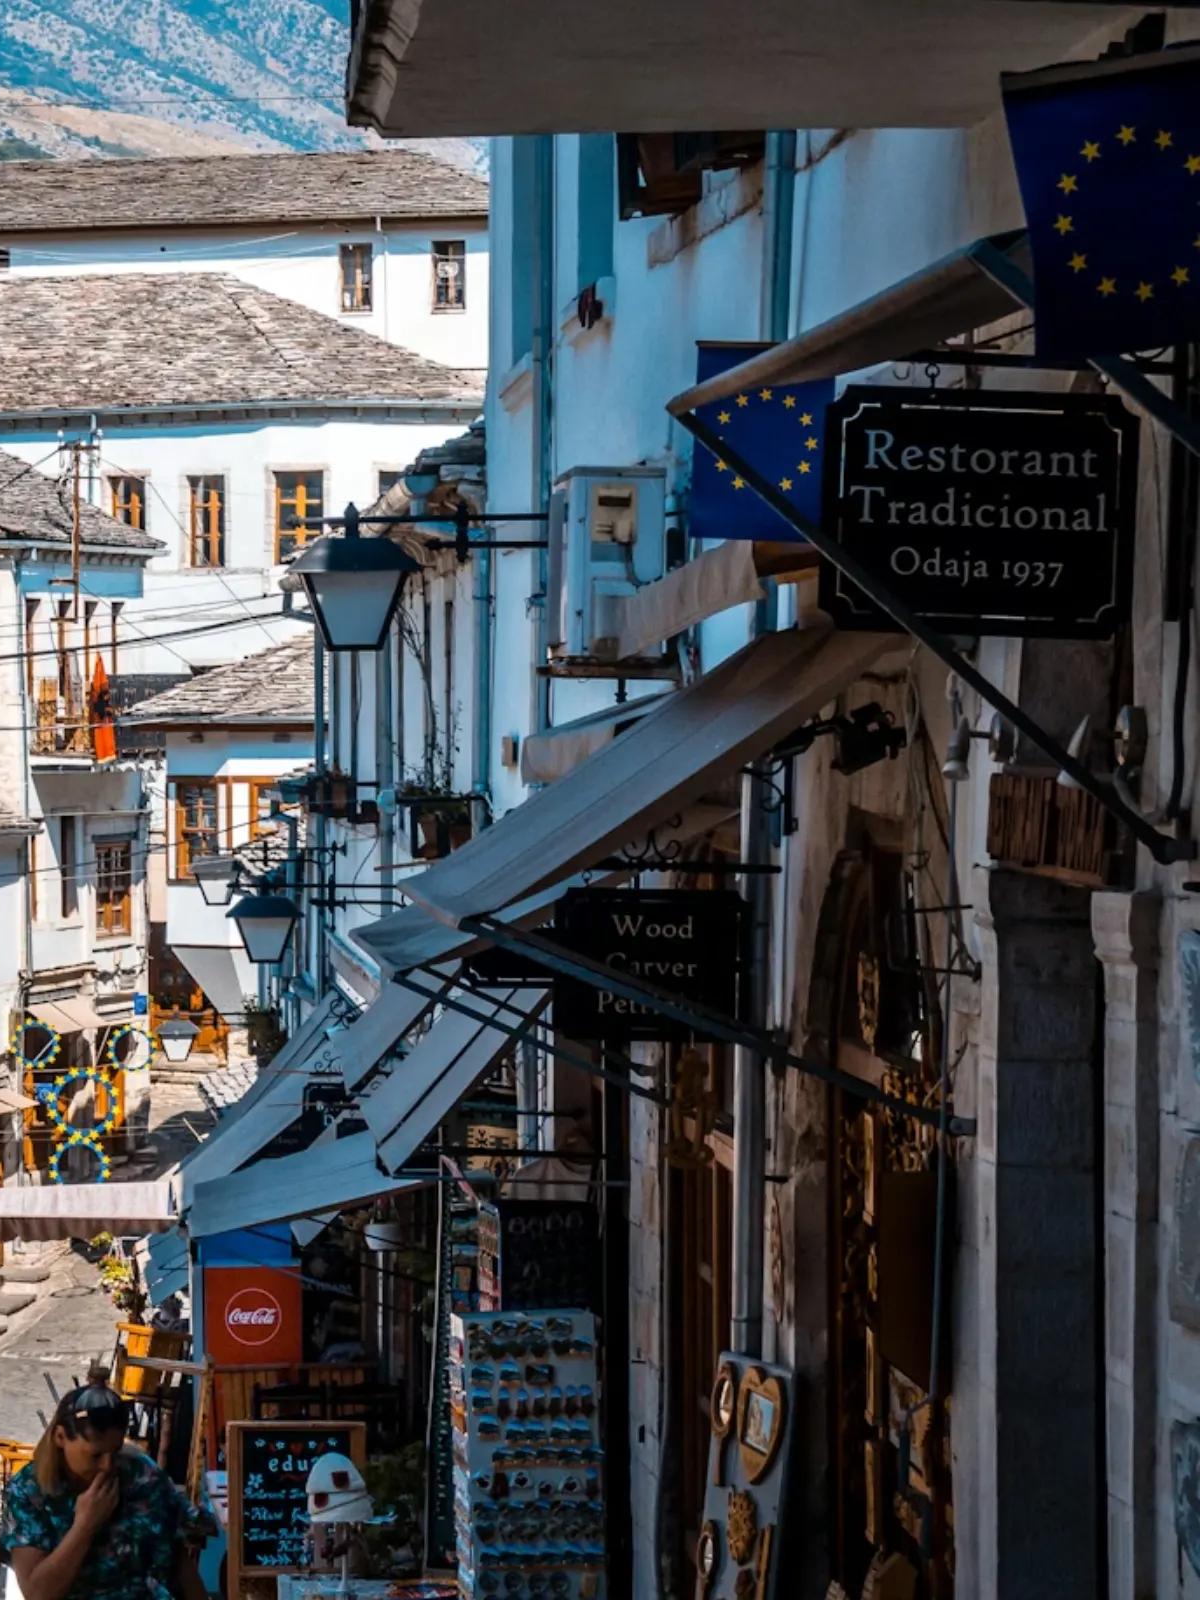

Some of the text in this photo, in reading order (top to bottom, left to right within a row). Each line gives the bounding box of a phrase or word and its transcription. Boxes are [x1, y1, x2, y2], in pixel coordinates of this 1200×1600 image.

[864, 428, 1099, 478] Restorant
[850, 485, 1109, 532] Tradicional
[890, 546, 1065, 588] Odaja 1937
[610, 914, 694, 939] Wood
[267, 1453, 320, 1473] edu
